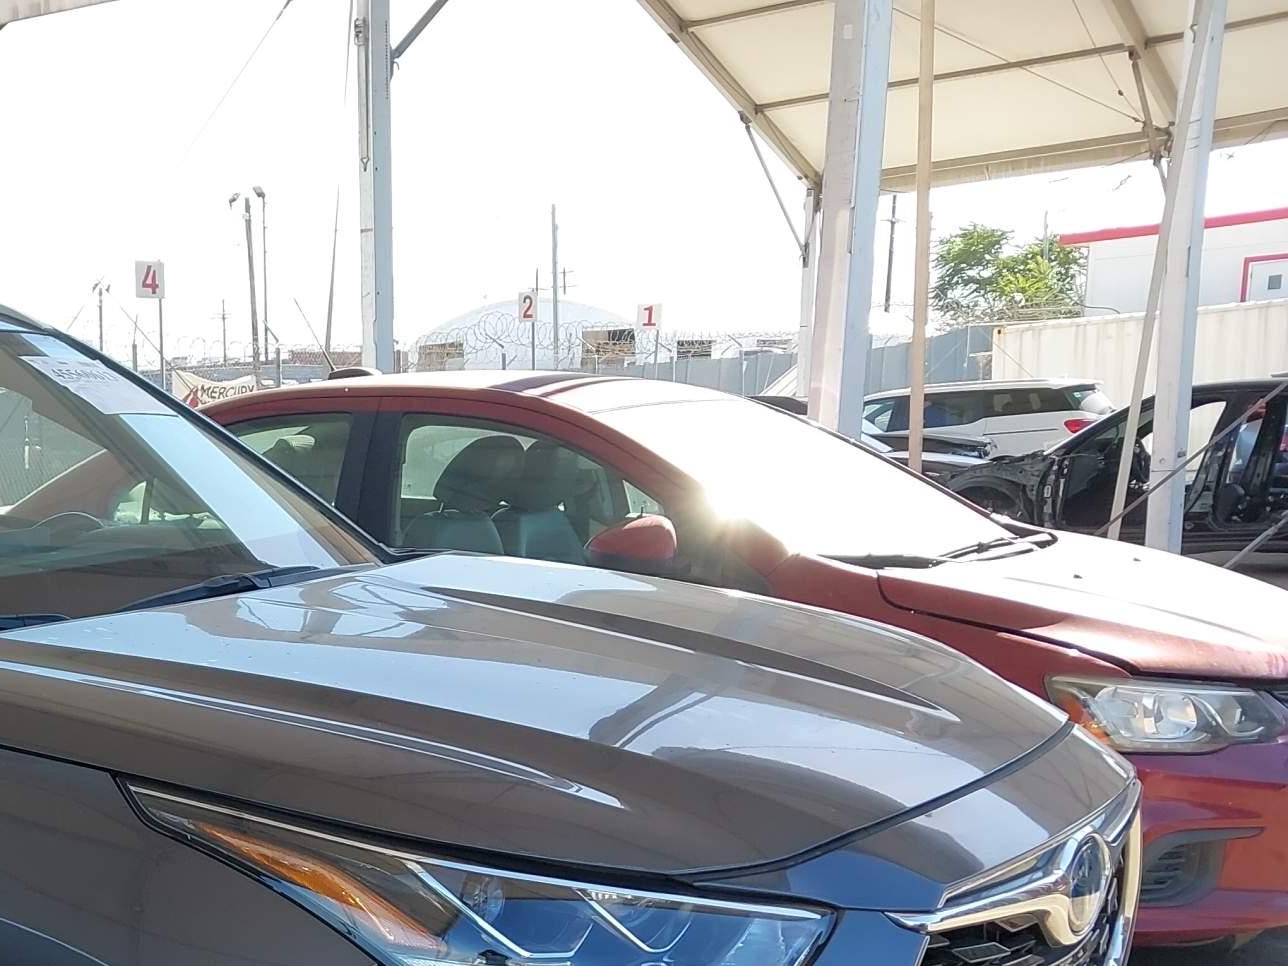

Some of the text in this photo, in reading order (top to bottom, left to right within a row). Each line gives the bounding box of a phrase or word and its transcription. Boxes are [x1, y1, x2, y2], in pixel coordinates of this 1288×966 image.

[142, 265, 159, 294] 4
[522, 295, 534, 319] 2
[642, 305, 657, 327] 1
